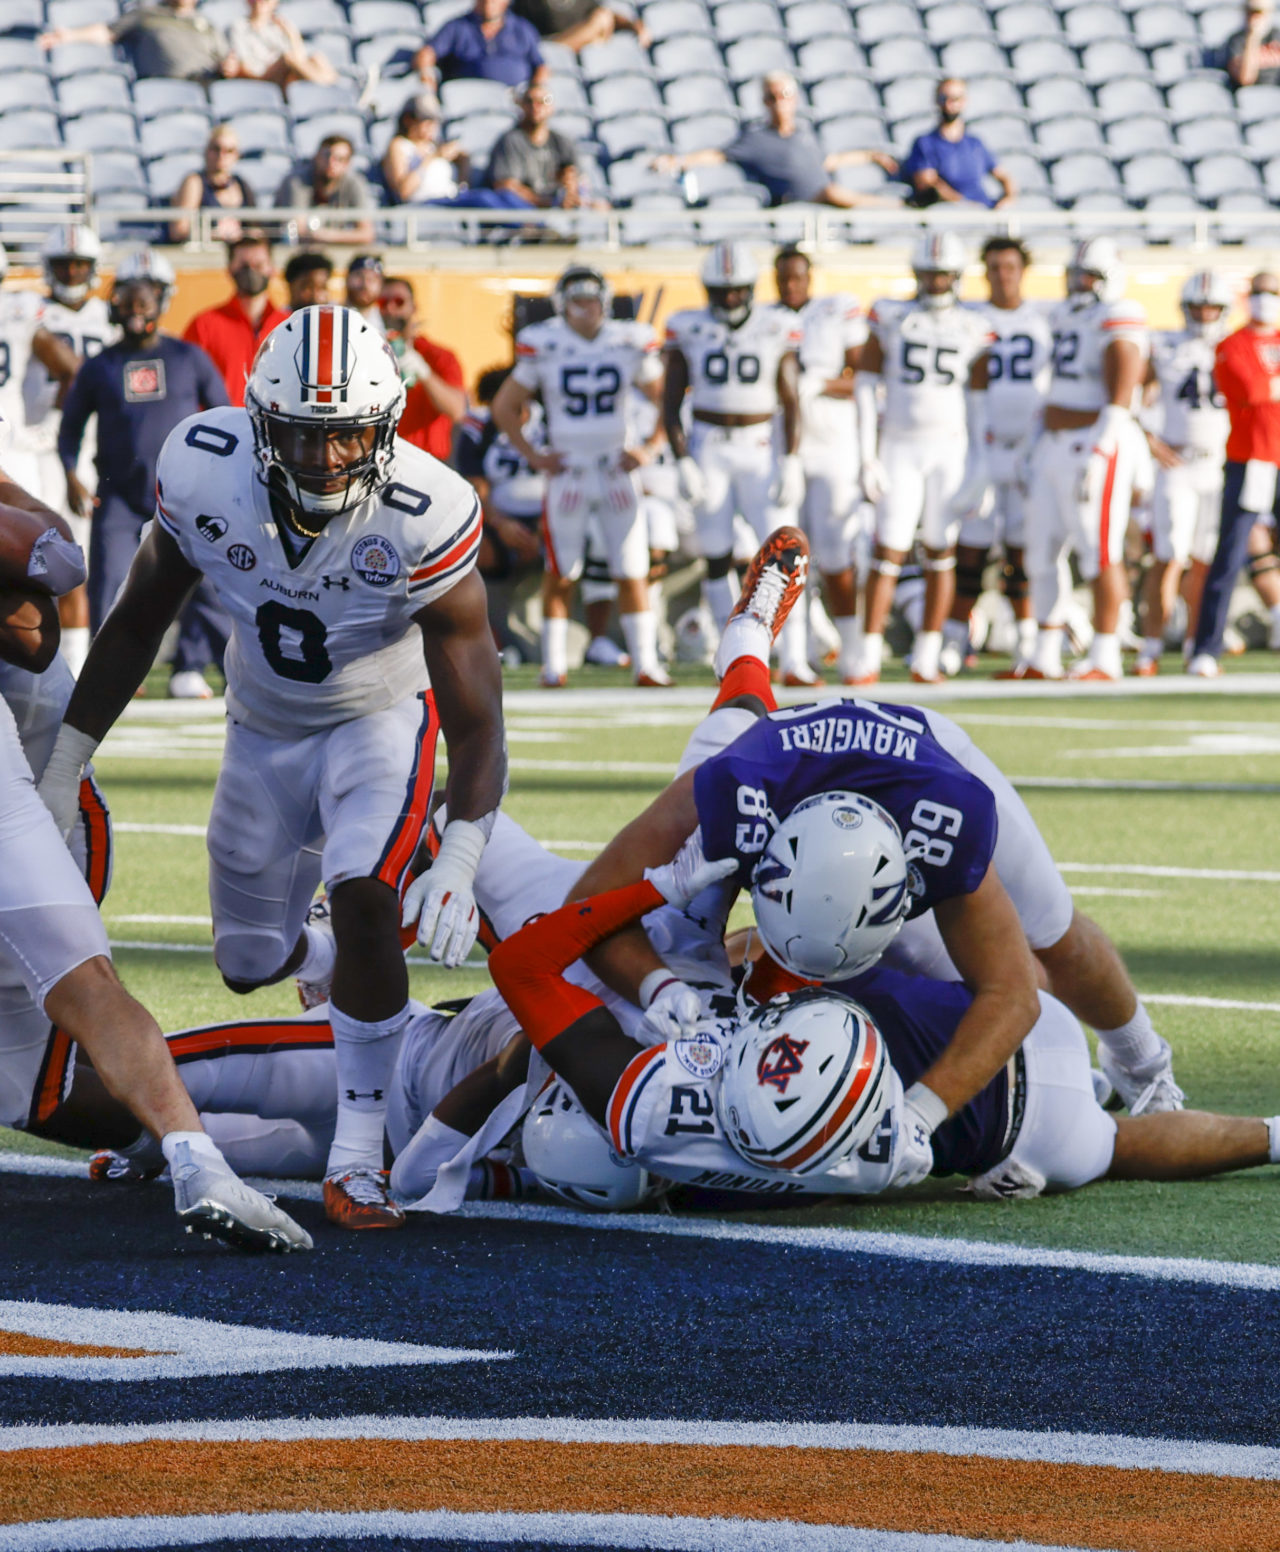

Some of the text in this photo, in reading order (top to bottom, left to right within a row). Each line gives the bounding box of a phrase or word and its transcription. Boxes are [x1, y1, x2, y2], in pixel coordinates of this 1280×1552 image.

[902, 341, 958, 386] 55
[561, 365, 621, 417] 52
[185, 424, 239, 457] 0
[381, 482, 432, 517] 0
[228, 545, 256, 569] SEC
[355, 538, 396, 560] CITRUS BOWL
[260, 578, 320, 601] AUBURN
[365, 572, 388, 583] Vrbo
[255, 600, 333, 684] 0
[777, 717, 918, 762] MANGIERI
[664, 1086, 715, 1136] 21
